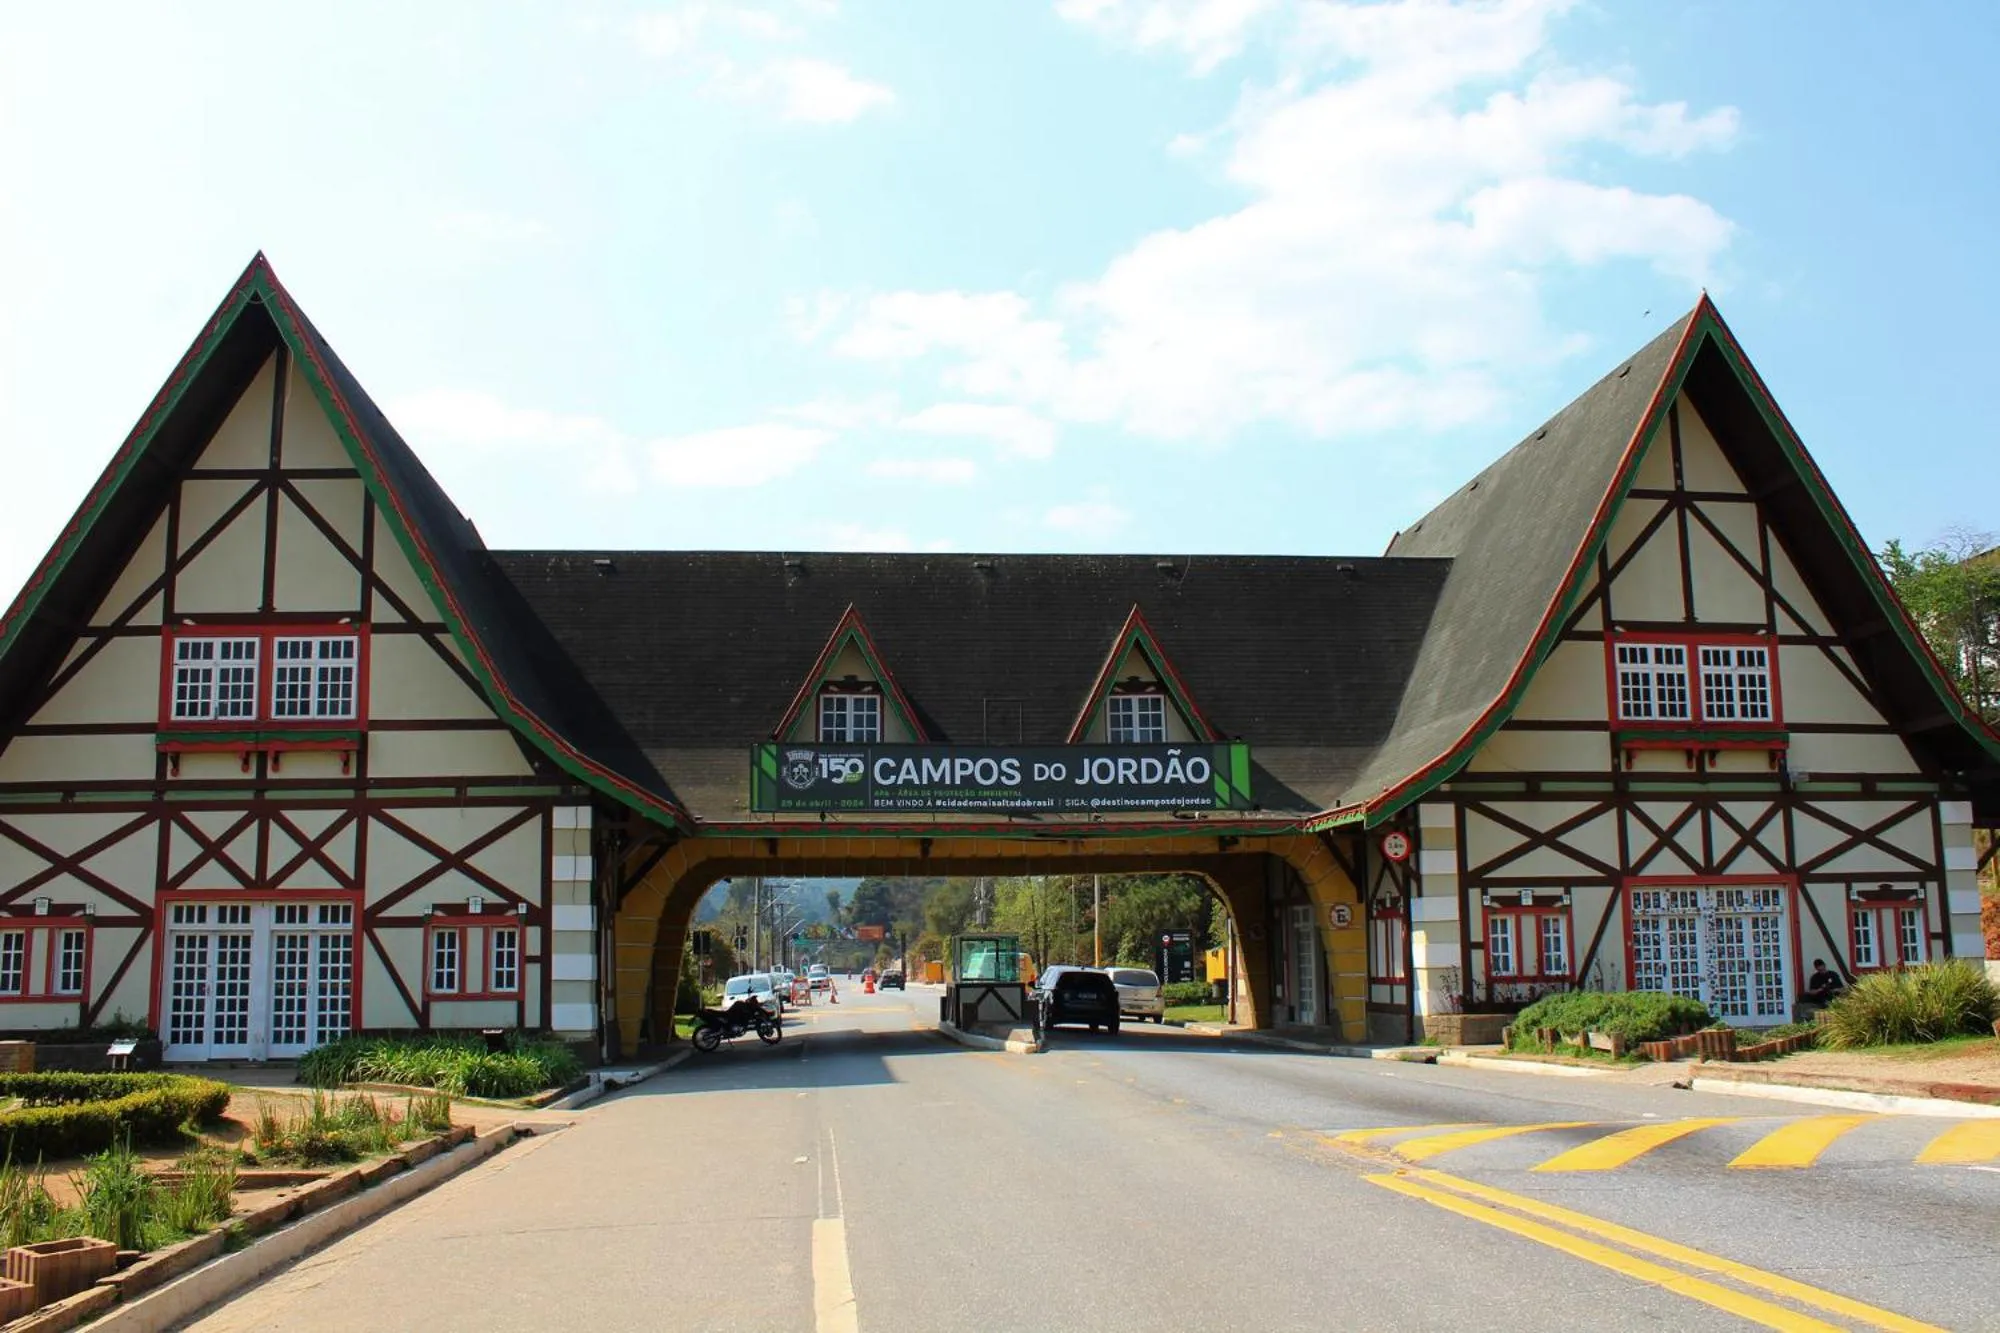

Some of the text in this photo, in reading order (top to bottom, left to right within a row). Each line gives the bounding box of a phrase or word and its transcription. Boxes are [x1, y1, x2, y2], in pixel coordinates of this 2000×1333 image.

[818, 757, 865, 785] 150
[873, 749, 1211, 786] CAMPOS DO JORDÃO
[874, 799, 893, 807] BEM
[896, 799, 924, 807] VINDO
